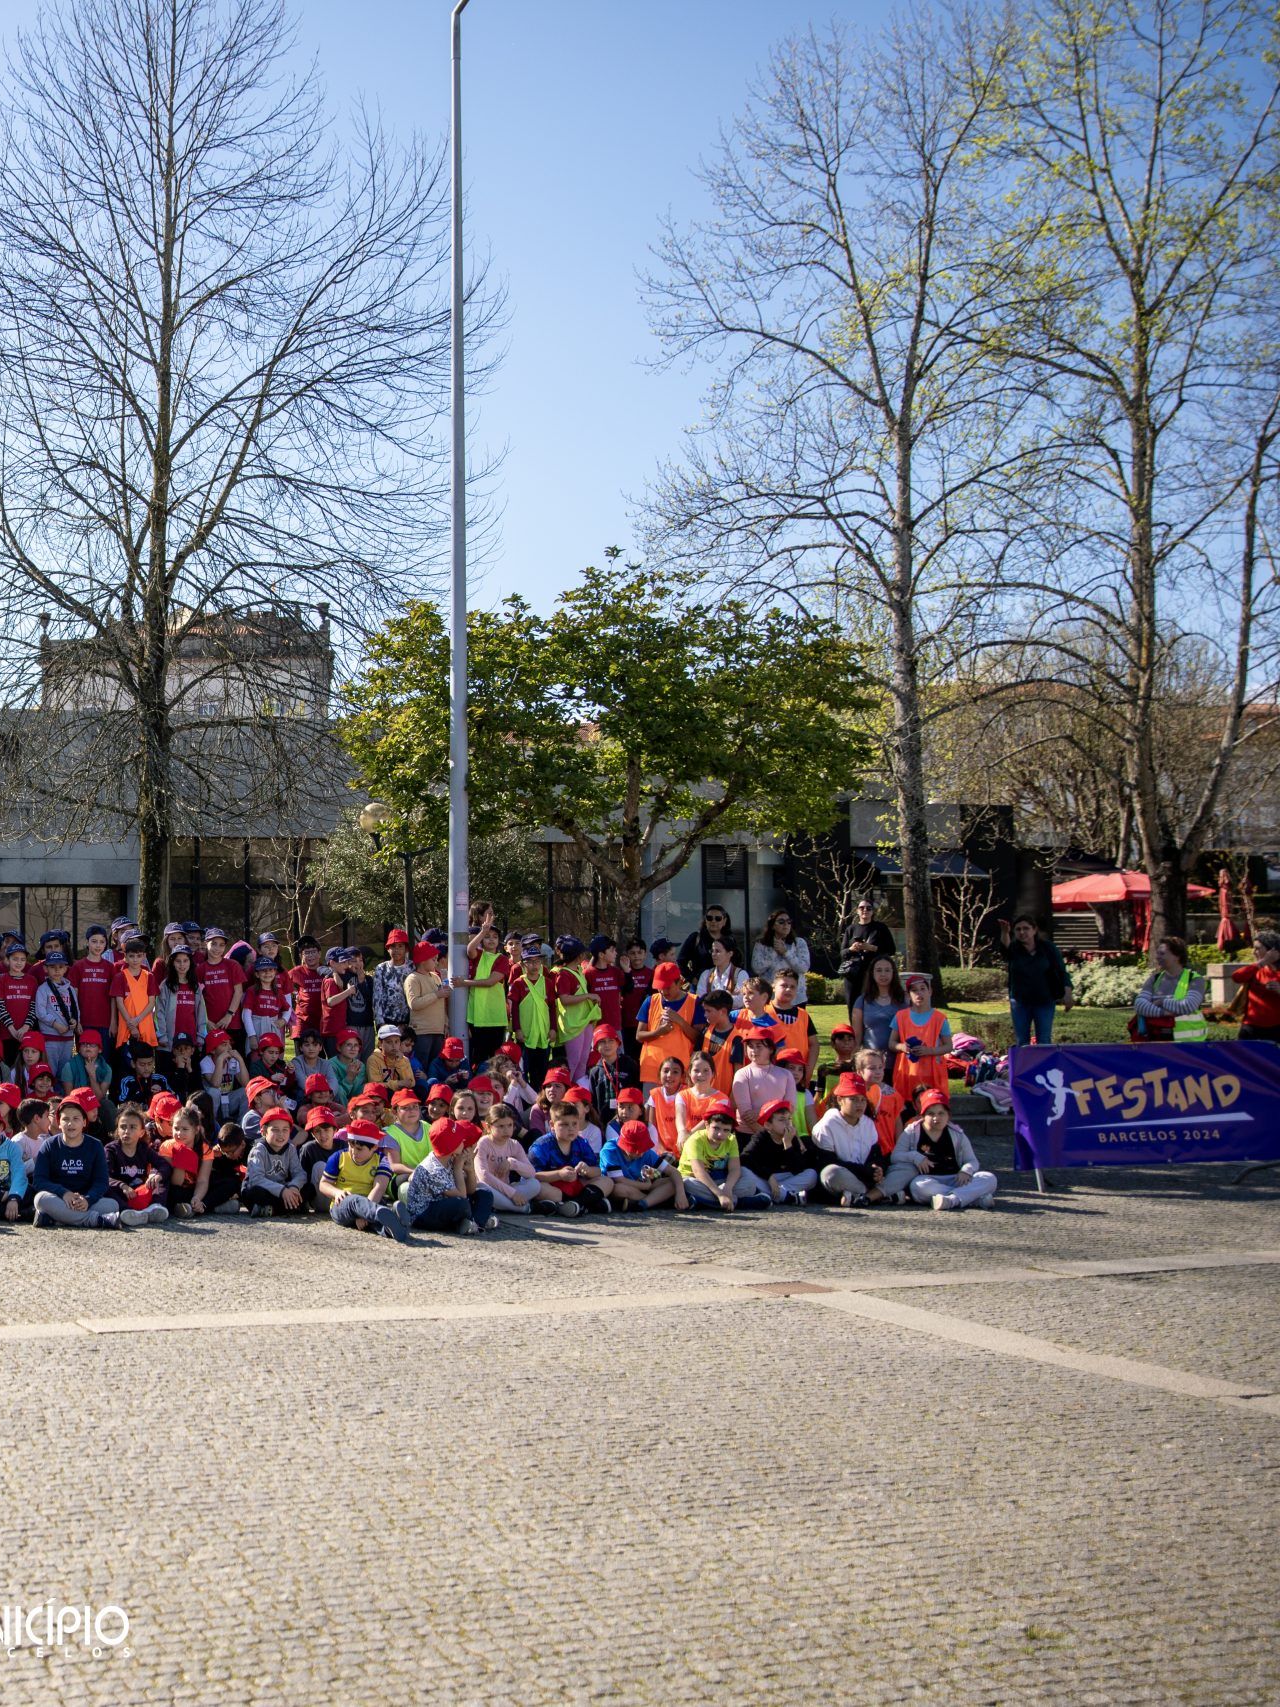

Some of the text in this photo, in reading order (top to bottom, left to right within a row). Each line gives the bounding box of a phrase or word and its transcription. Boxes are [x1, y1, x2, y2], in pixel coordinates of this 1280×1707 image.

[1070, 1067, 1241, 1119] FESTAND
[1098, 1129, 1220, 1143] BARCELOS 2024
